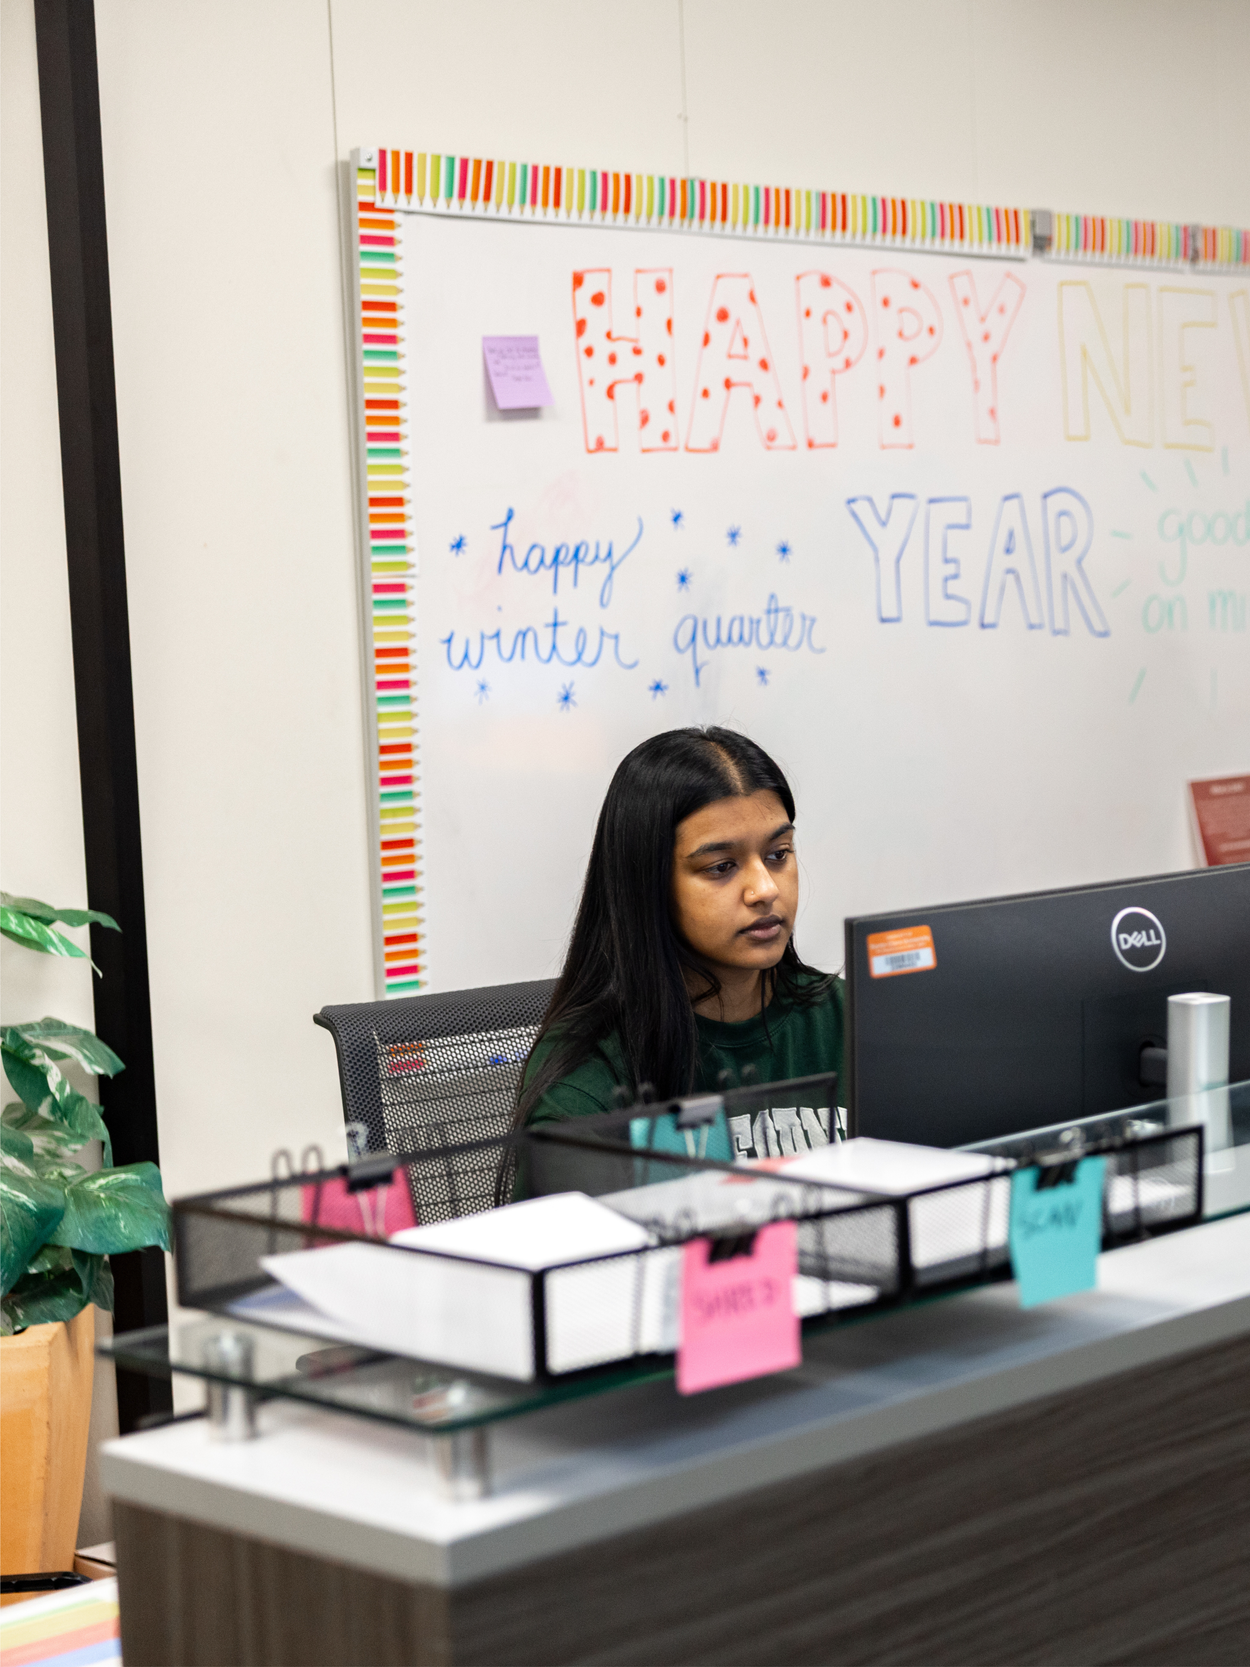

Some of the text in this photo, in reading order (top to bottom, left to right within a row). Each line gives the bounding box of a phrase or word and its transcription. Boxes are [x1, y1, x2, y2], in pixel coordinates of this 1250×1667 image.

[572, 267, 1027, 453] HAPPY
[490, 507, 644, 609] happy
[845, 486, 1112, 638] YEAR
[439, 592, 827, 688] winter quarter
[1141, 592, 1188, 634] on
[1118, 929, 1161, 950] DELL
